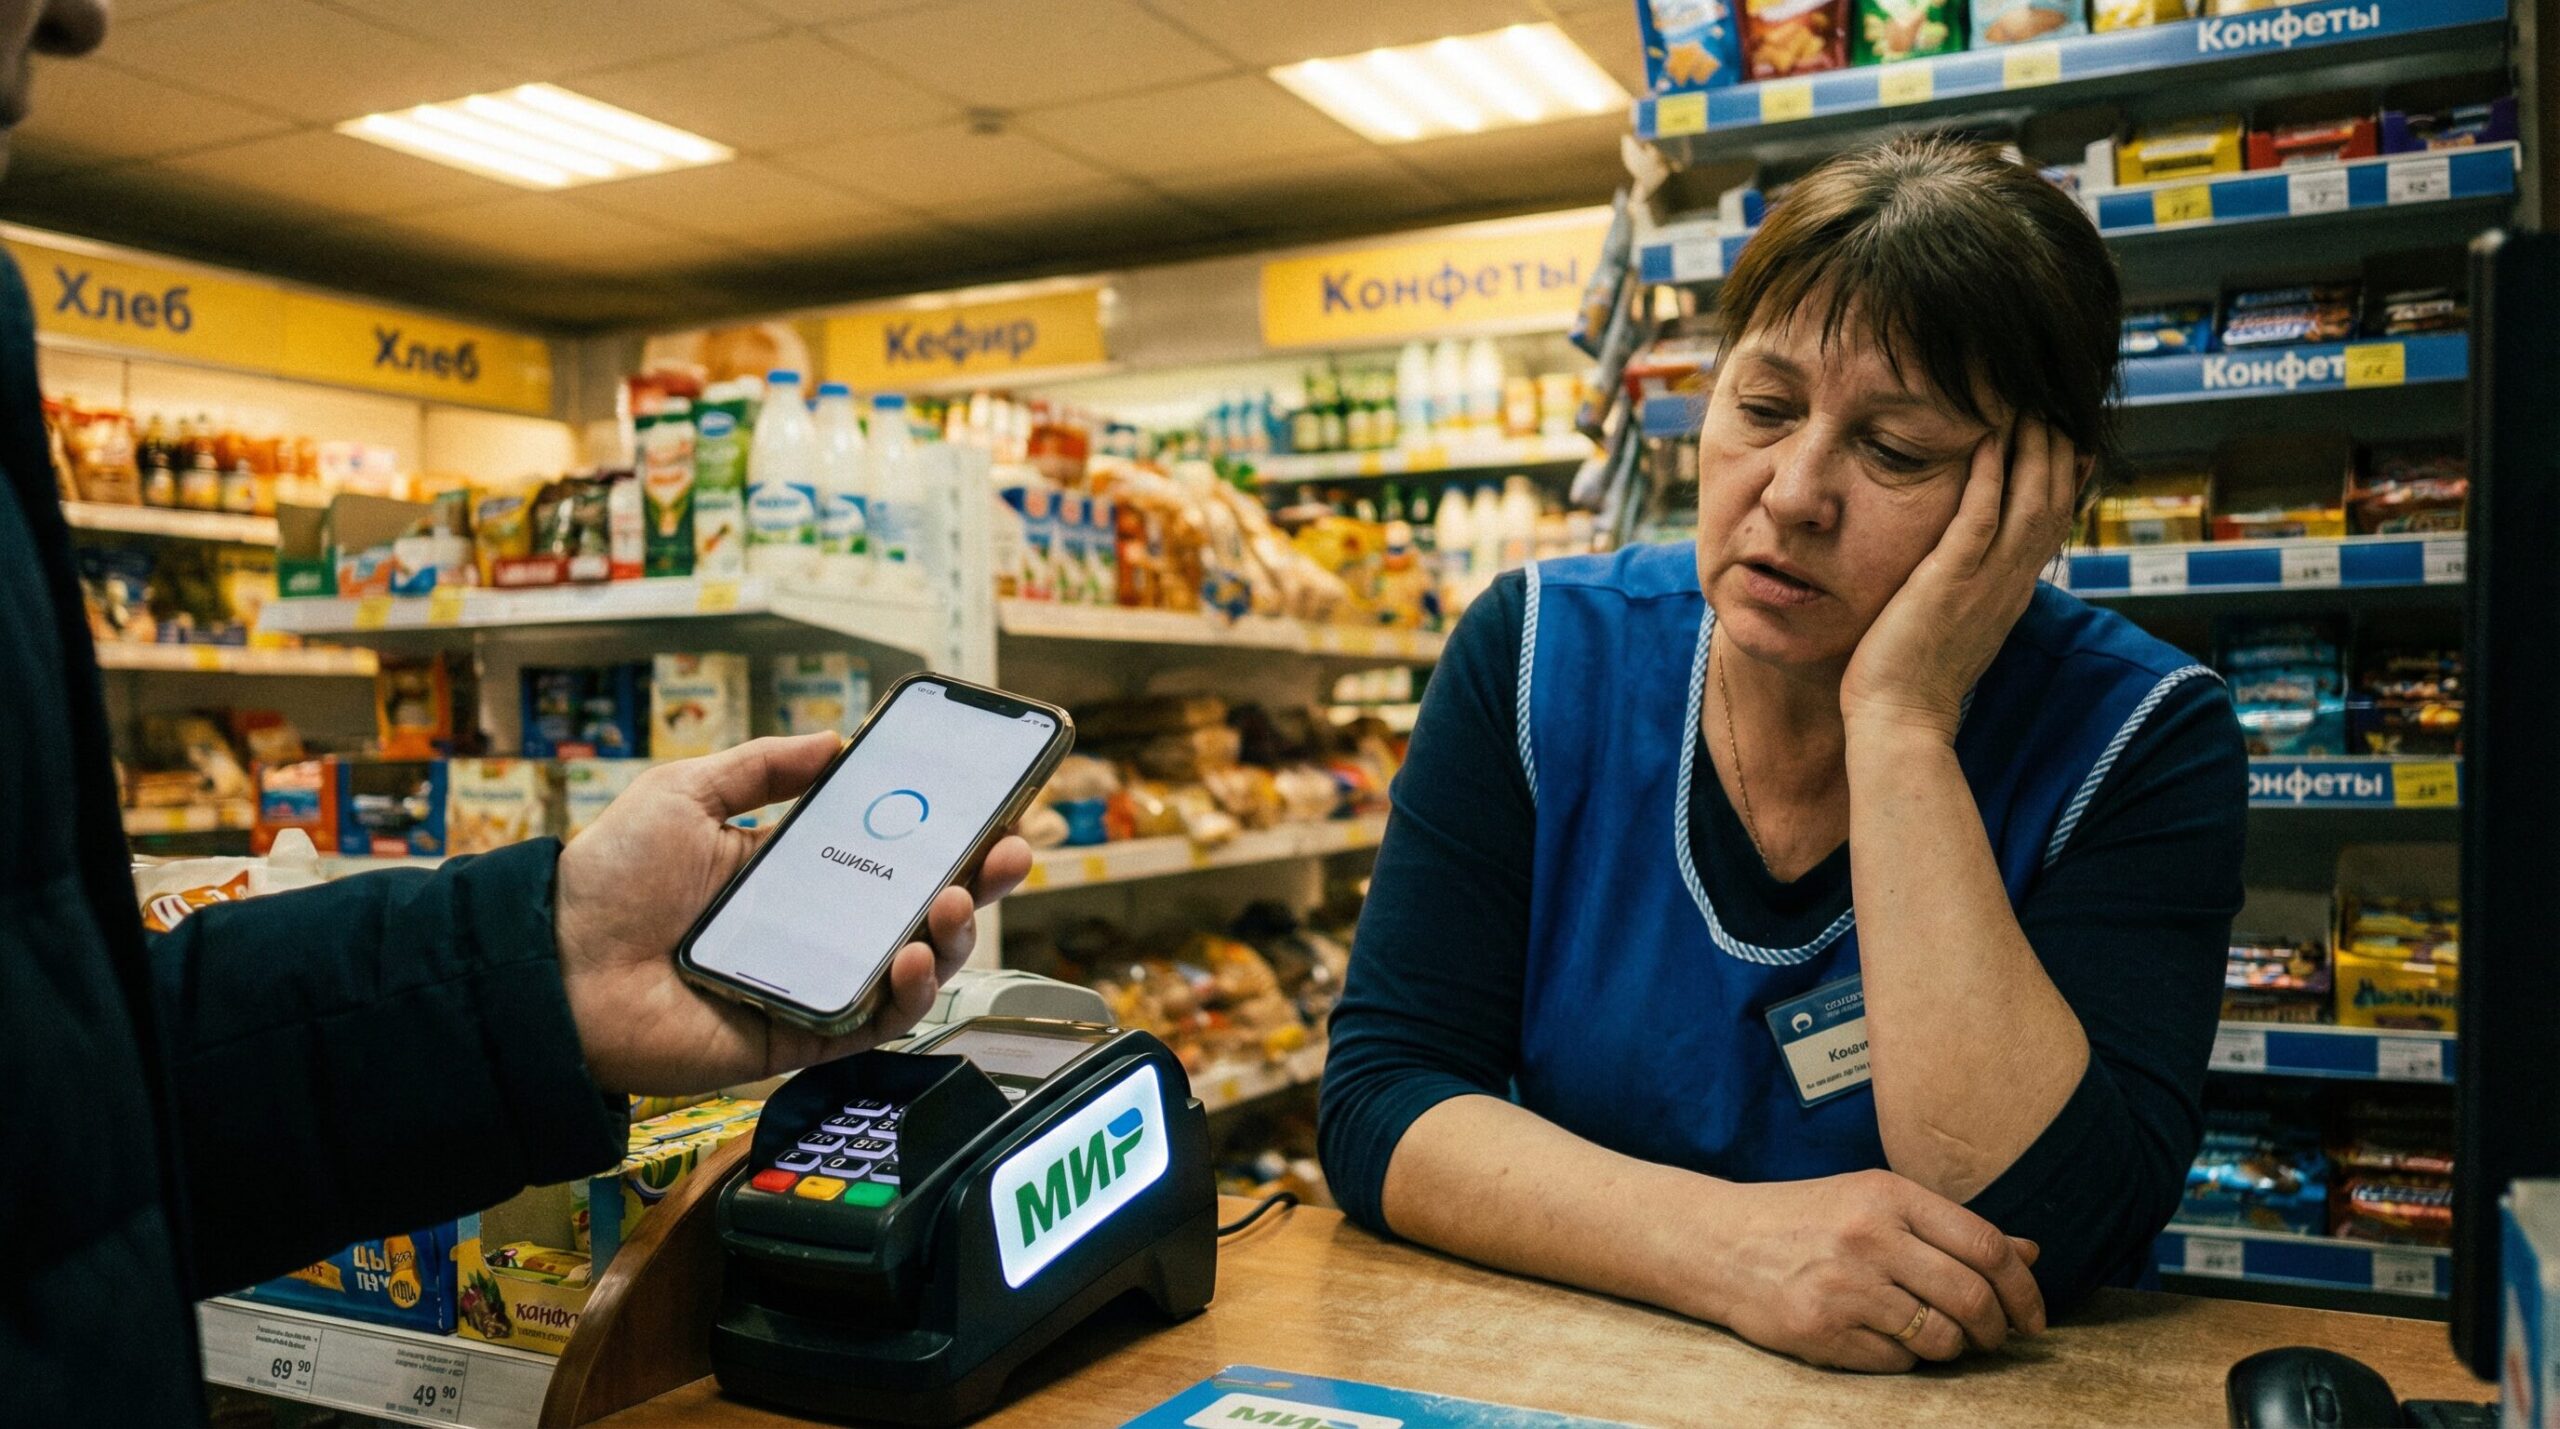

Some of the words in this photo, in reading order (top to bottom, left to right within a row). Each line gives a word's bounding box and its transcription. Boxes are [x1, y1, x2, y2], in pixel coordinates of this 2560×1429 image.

[2197, 3, 2380, 52] Конфеты
[54, 265, 193, 334] Хлеб
[1323, 259, 1577, 315] Конфеты
[373, 324, 481, 383] Хлеб
[886, 316, 1037, 366] Кефир
[821, 846, 894, 880] ОШИБКА
[1015, 1107, 1144, 1248] МИР
[271, 1357, 293, 1380] 69
[297, 1359, 311, 1373] 90
[412, 1384, 437, 1407] 49
[442, 1385, 457, 1400] 90
